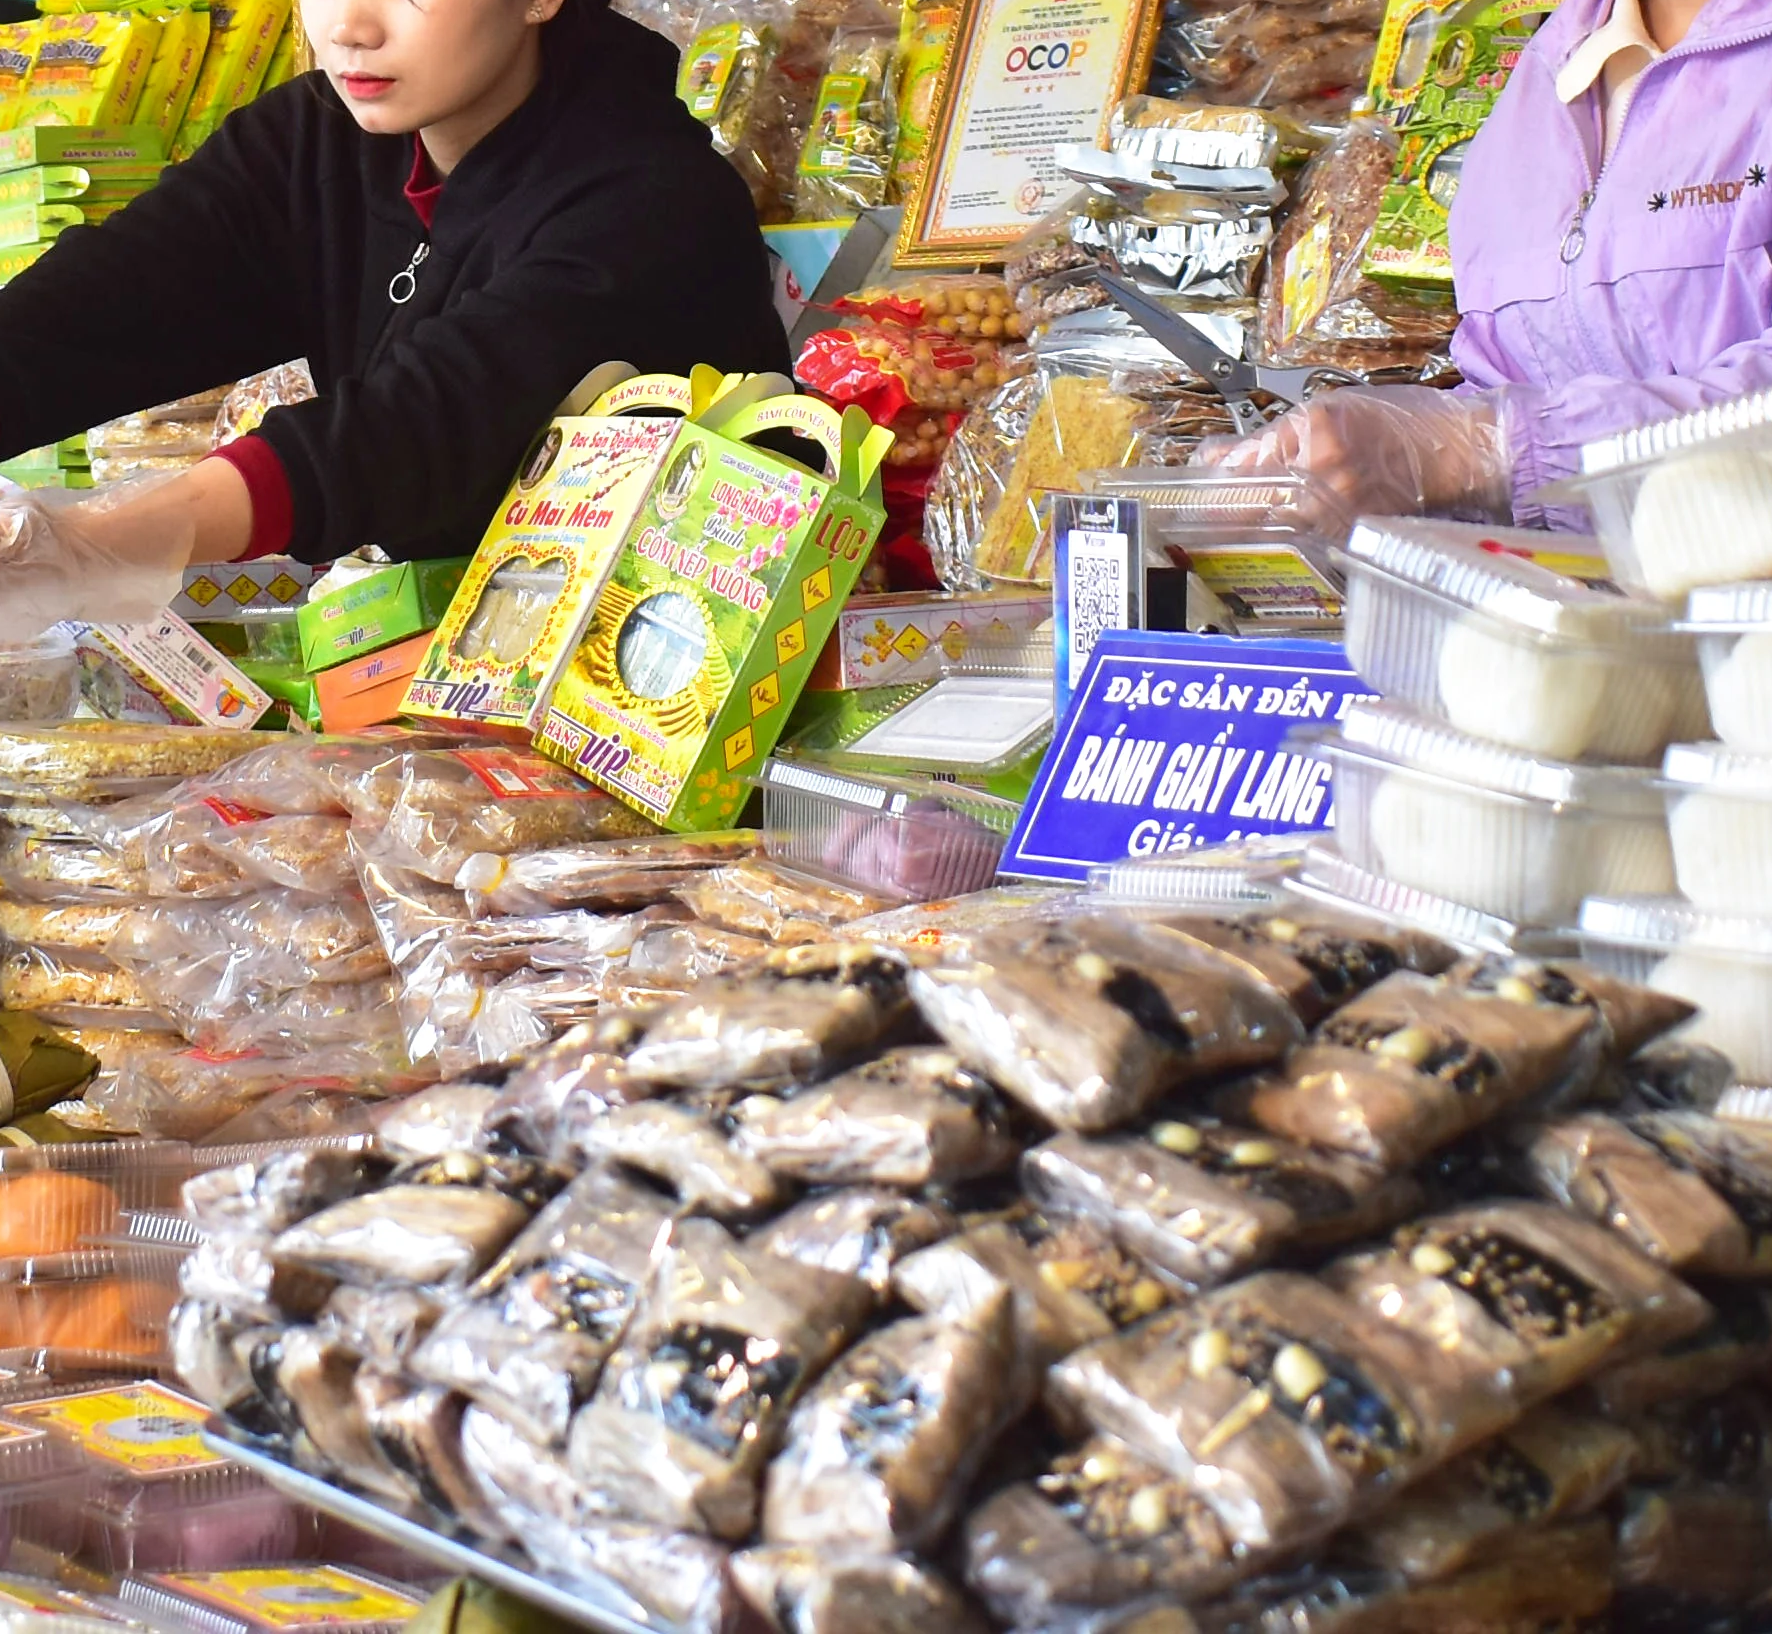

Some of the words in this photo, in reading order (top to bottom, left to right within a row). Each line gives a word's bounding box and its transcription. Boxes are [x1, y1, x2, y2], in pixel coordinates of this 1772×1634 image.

[1006, 40, 1088, 73] OCOP
[710, 479, 741, 510] LONG
[815, 513, 868, 562] LỘC
[1102, 670, 1174, 712] ĐẶC
[1178, 672, 1254, 712] SẢN
[1253, 676, 1334, 719] ĐỀN
[543, 717, 580, 751] HÀNG
